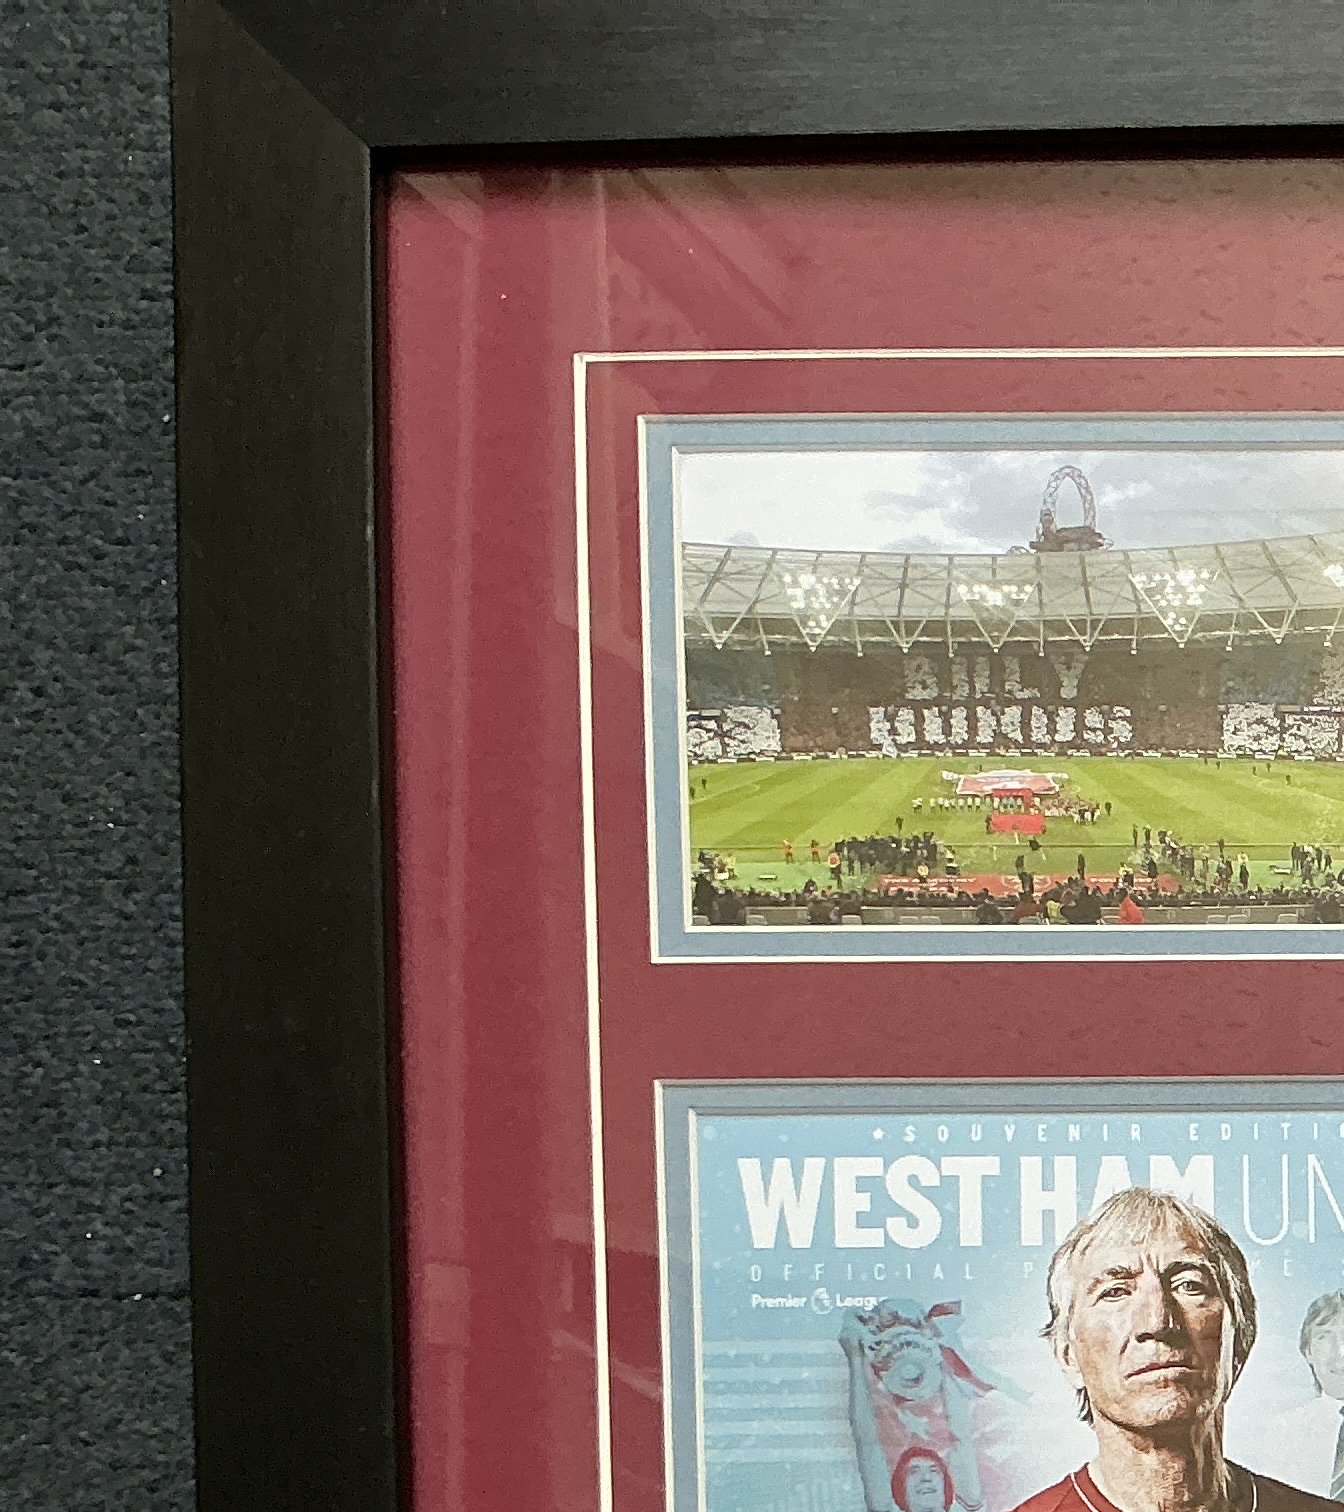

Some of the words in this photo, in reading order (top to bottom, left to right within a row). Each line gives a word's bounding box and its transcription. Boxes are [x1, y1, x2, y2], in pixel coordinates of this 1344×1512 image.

[903, 1123, 1141, 1142] SOUVENIR
[737, 1155, 1001, 1250] WEST
[1019, 1154, 1215, 1248] HAM
[750, 1262, 975, 1282] OFFICIAL
[751, 1293, 808, 1309] Premier
